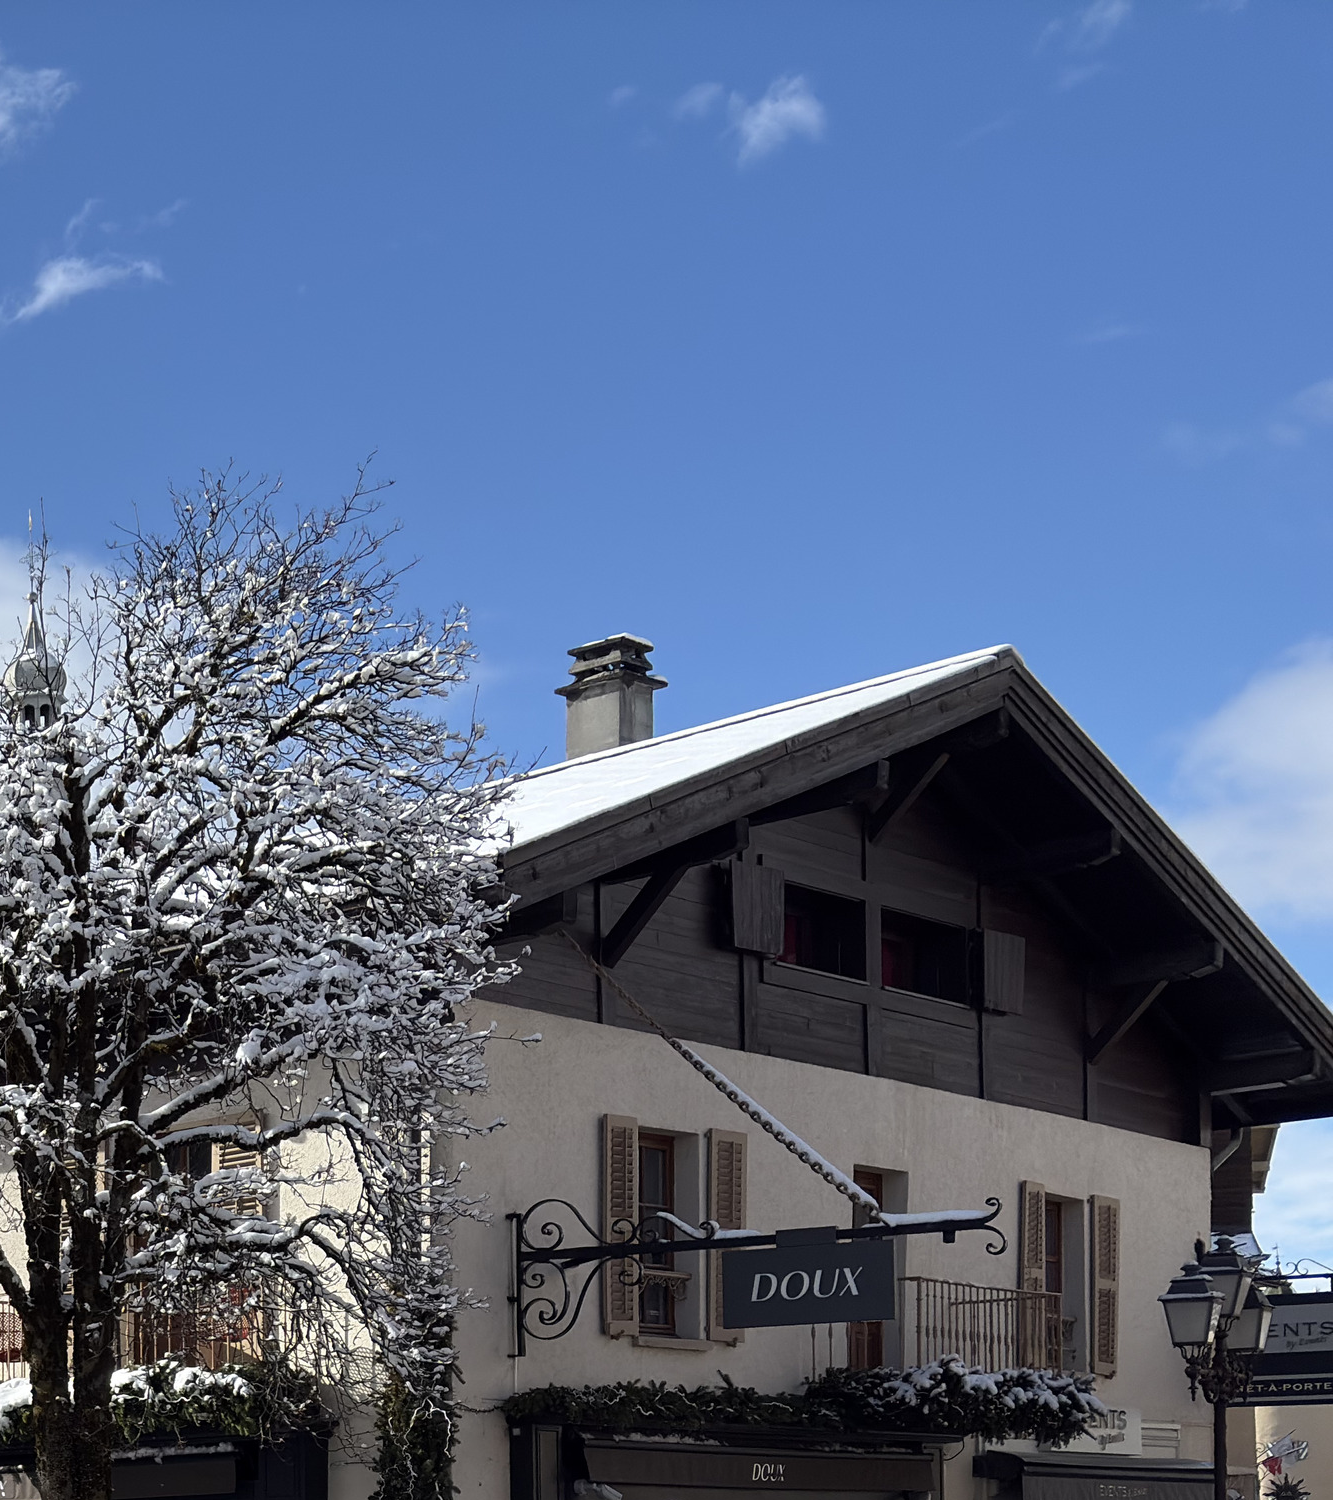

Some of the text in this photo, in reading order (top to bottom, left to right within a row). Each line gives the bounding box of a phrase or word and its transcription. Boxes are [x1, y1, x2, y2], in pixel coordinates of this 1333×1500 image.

[750, 1266, 863, 1302] DOUX
[1268, 1321, 1333, 1338] ENTS
[752, 1463, 786, 1482] DOUX
